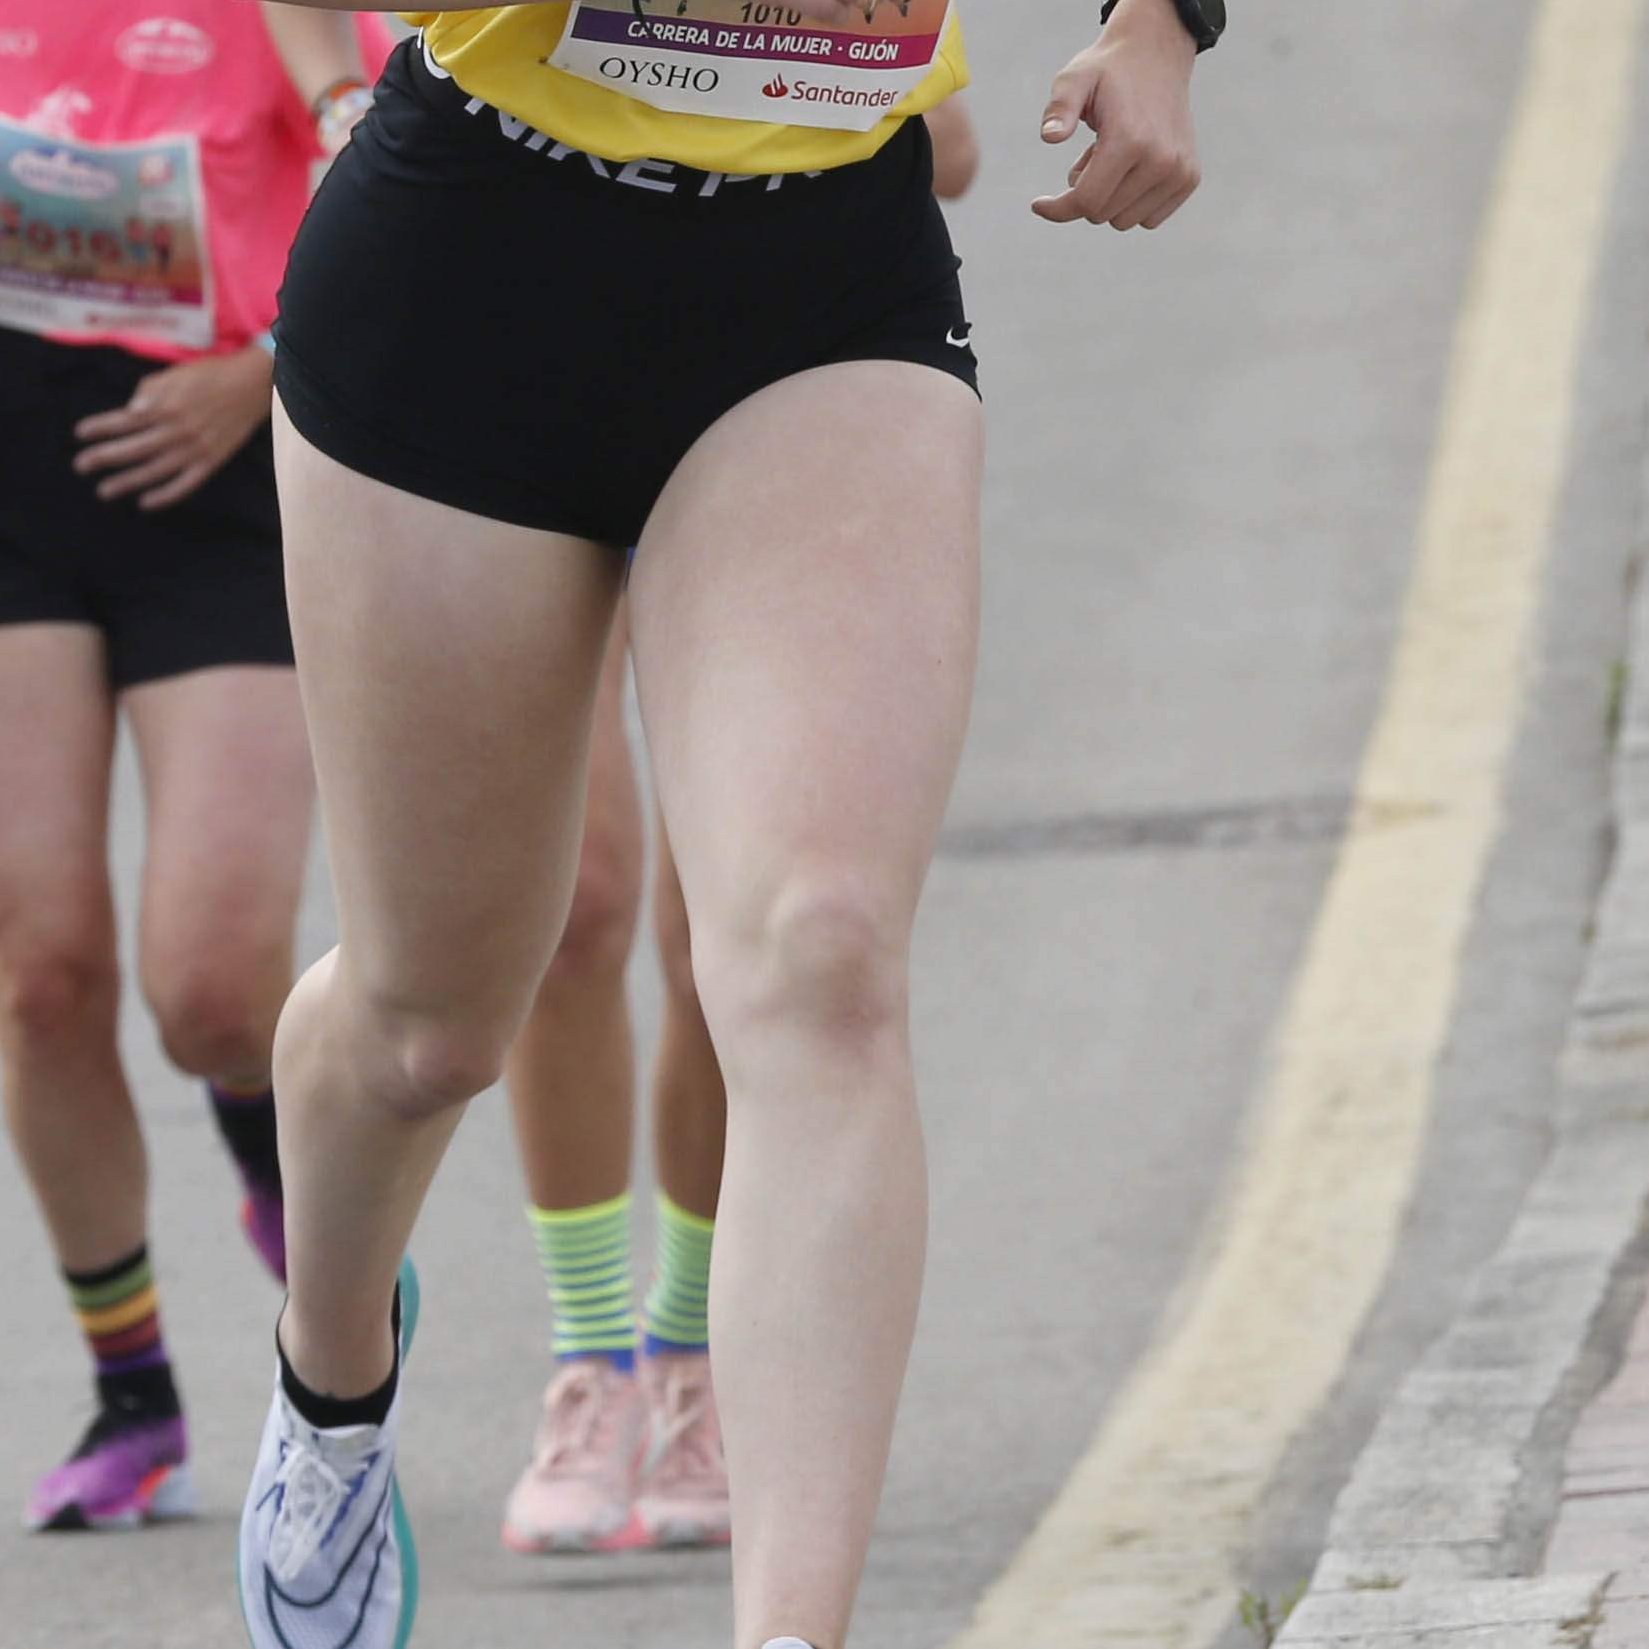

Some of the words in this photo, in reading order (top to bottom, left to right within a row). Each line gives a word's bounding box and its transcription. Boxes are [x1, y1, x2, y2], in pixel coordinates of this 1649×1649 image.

[627, 20, 710, 46] CARRERA
[715, 30, 740, 49] DE
[743, 32, 766, 51] LA
[771, 36, 832, 56] MUJER
[848, 38, 900, 62] GIJÓN
[599, 57, 720, 93] OYSHO
[791, 80, 899, 107] Santander
